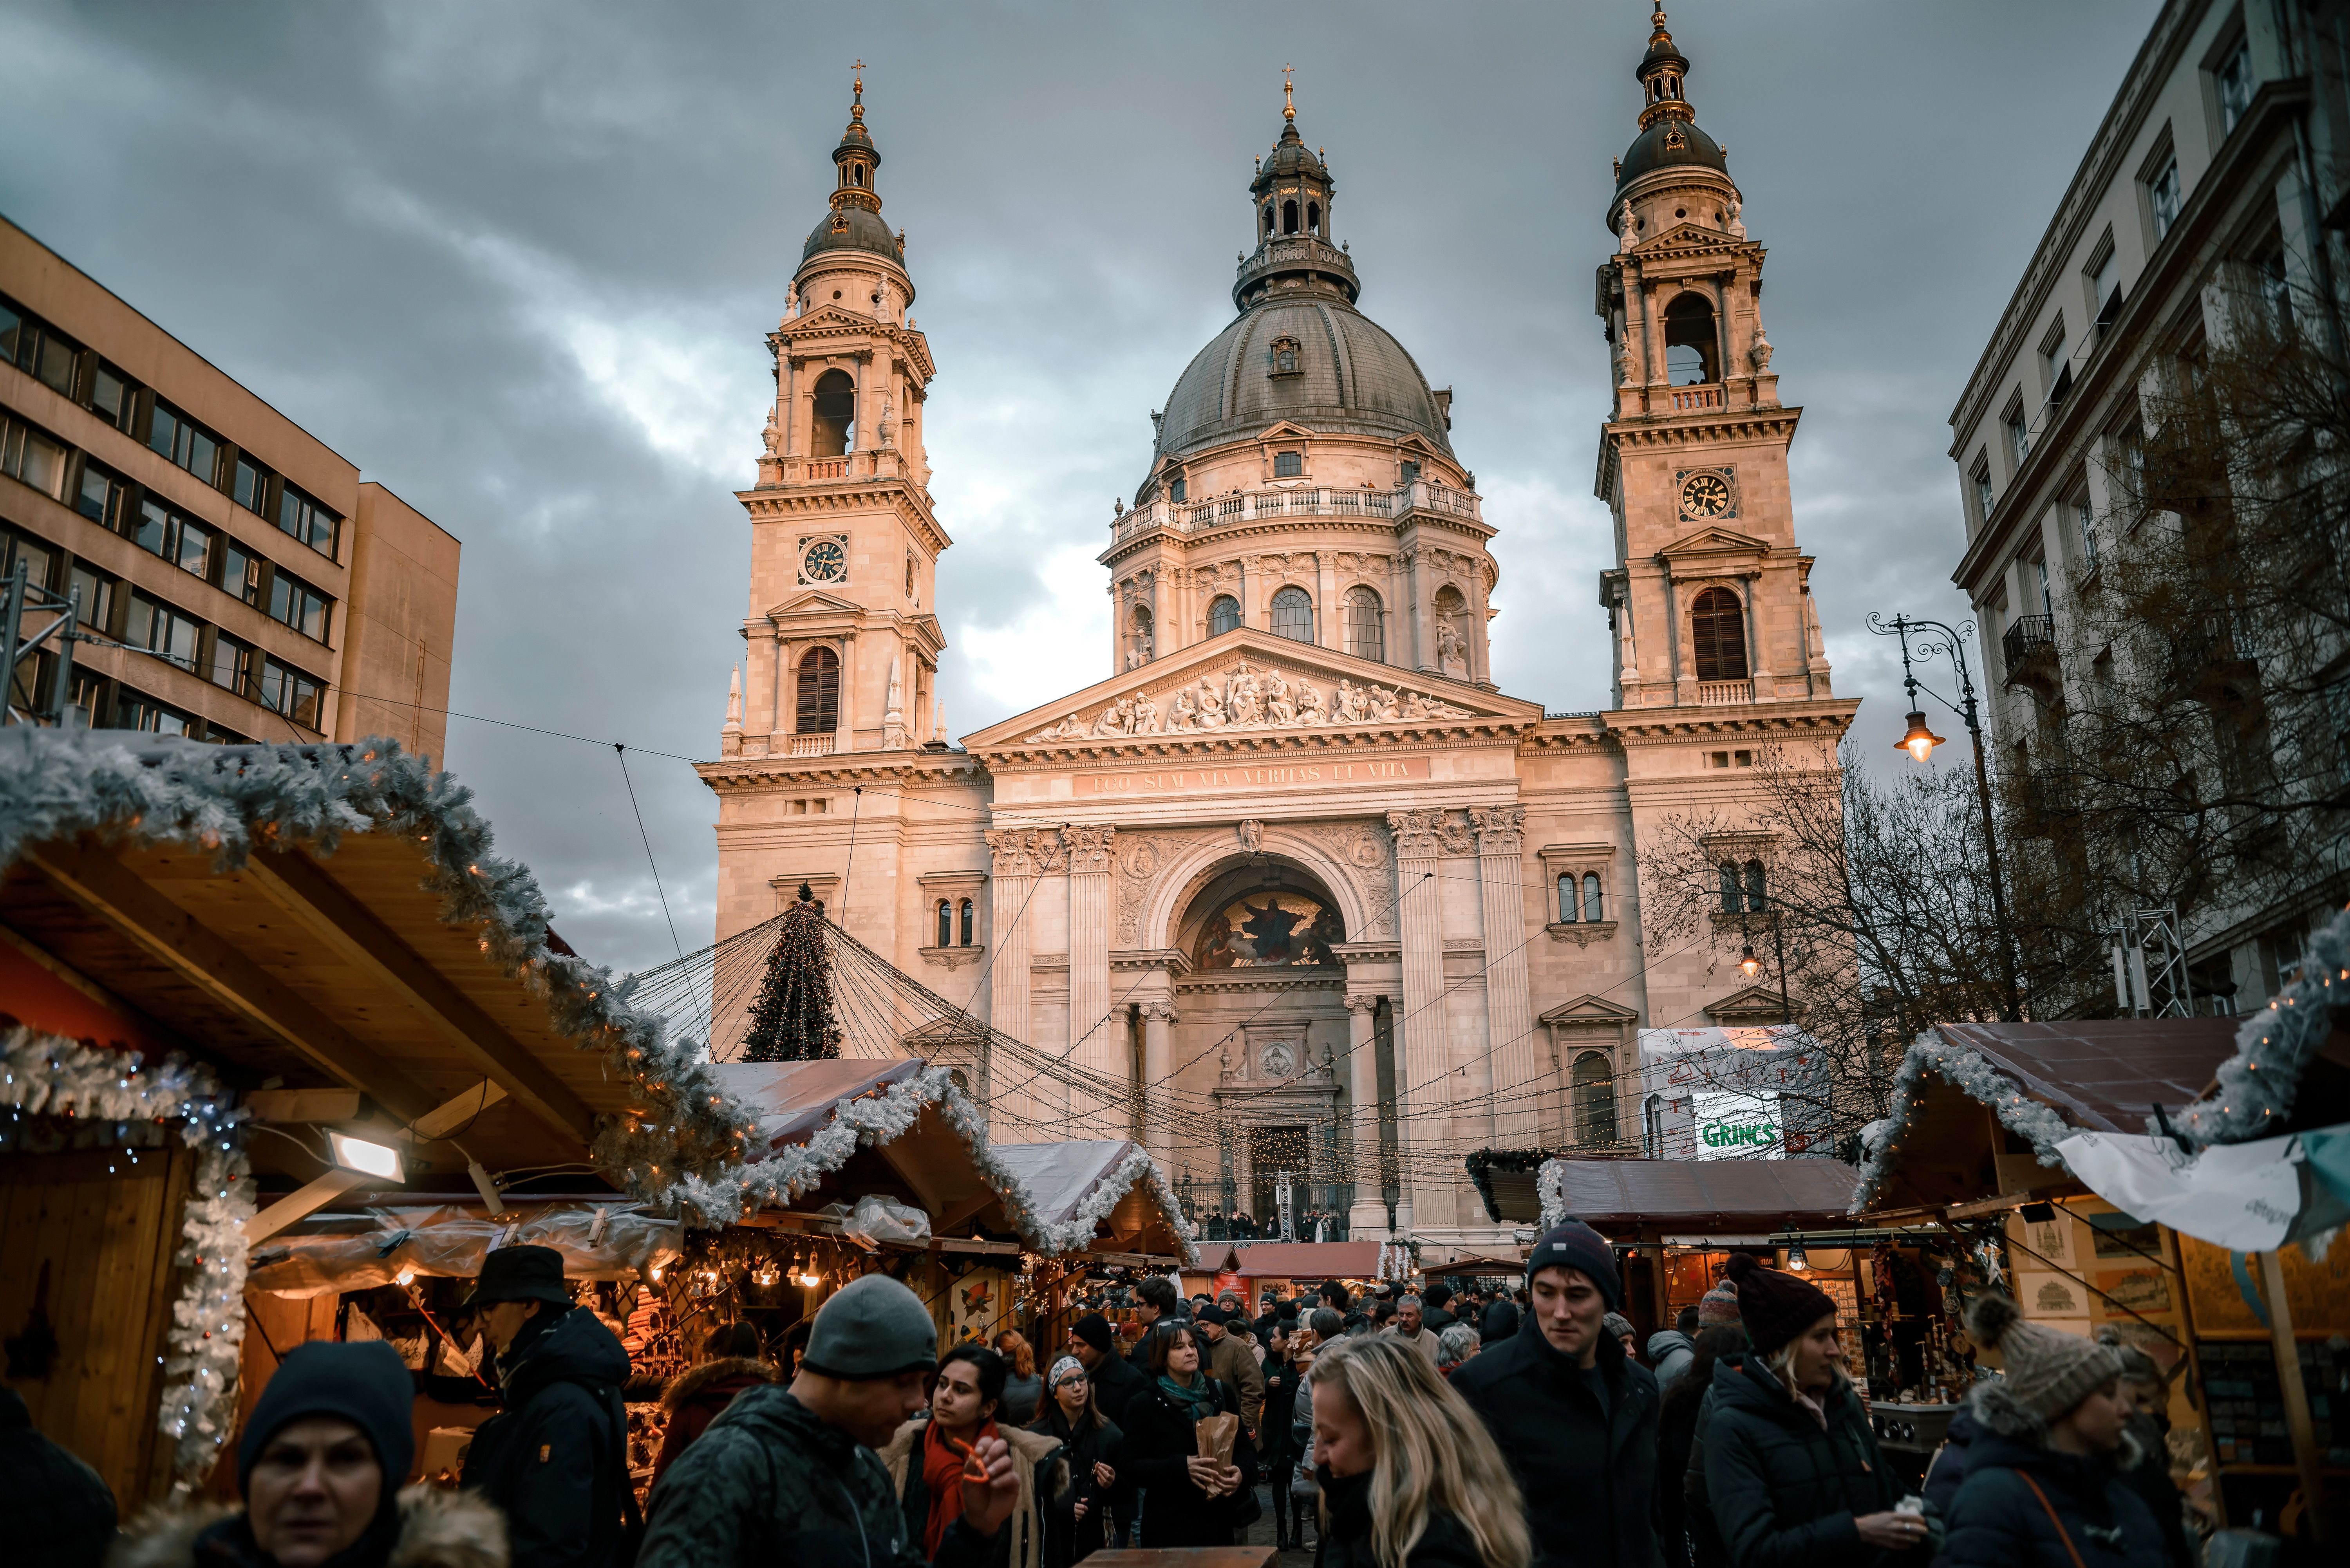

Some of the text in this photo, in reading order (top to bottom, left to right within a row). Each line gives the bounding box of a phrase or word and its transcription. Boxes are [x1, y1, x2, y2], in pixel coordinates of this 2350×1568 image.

[1692, 480, 1701, 490] XI
[1700, 478, 1708, 486] XII
[1710, 479, 1716, 488] I
[1687, 501, 1697, 511] VIII
[814, 546, 822, 555] XI
[808, 565, 817, 575] VIII
[1093, 762, 1410, 792] EGO SUM VIA VERITAS ET VITA
[1703, 1121, 1777, 1147] GRINCS
